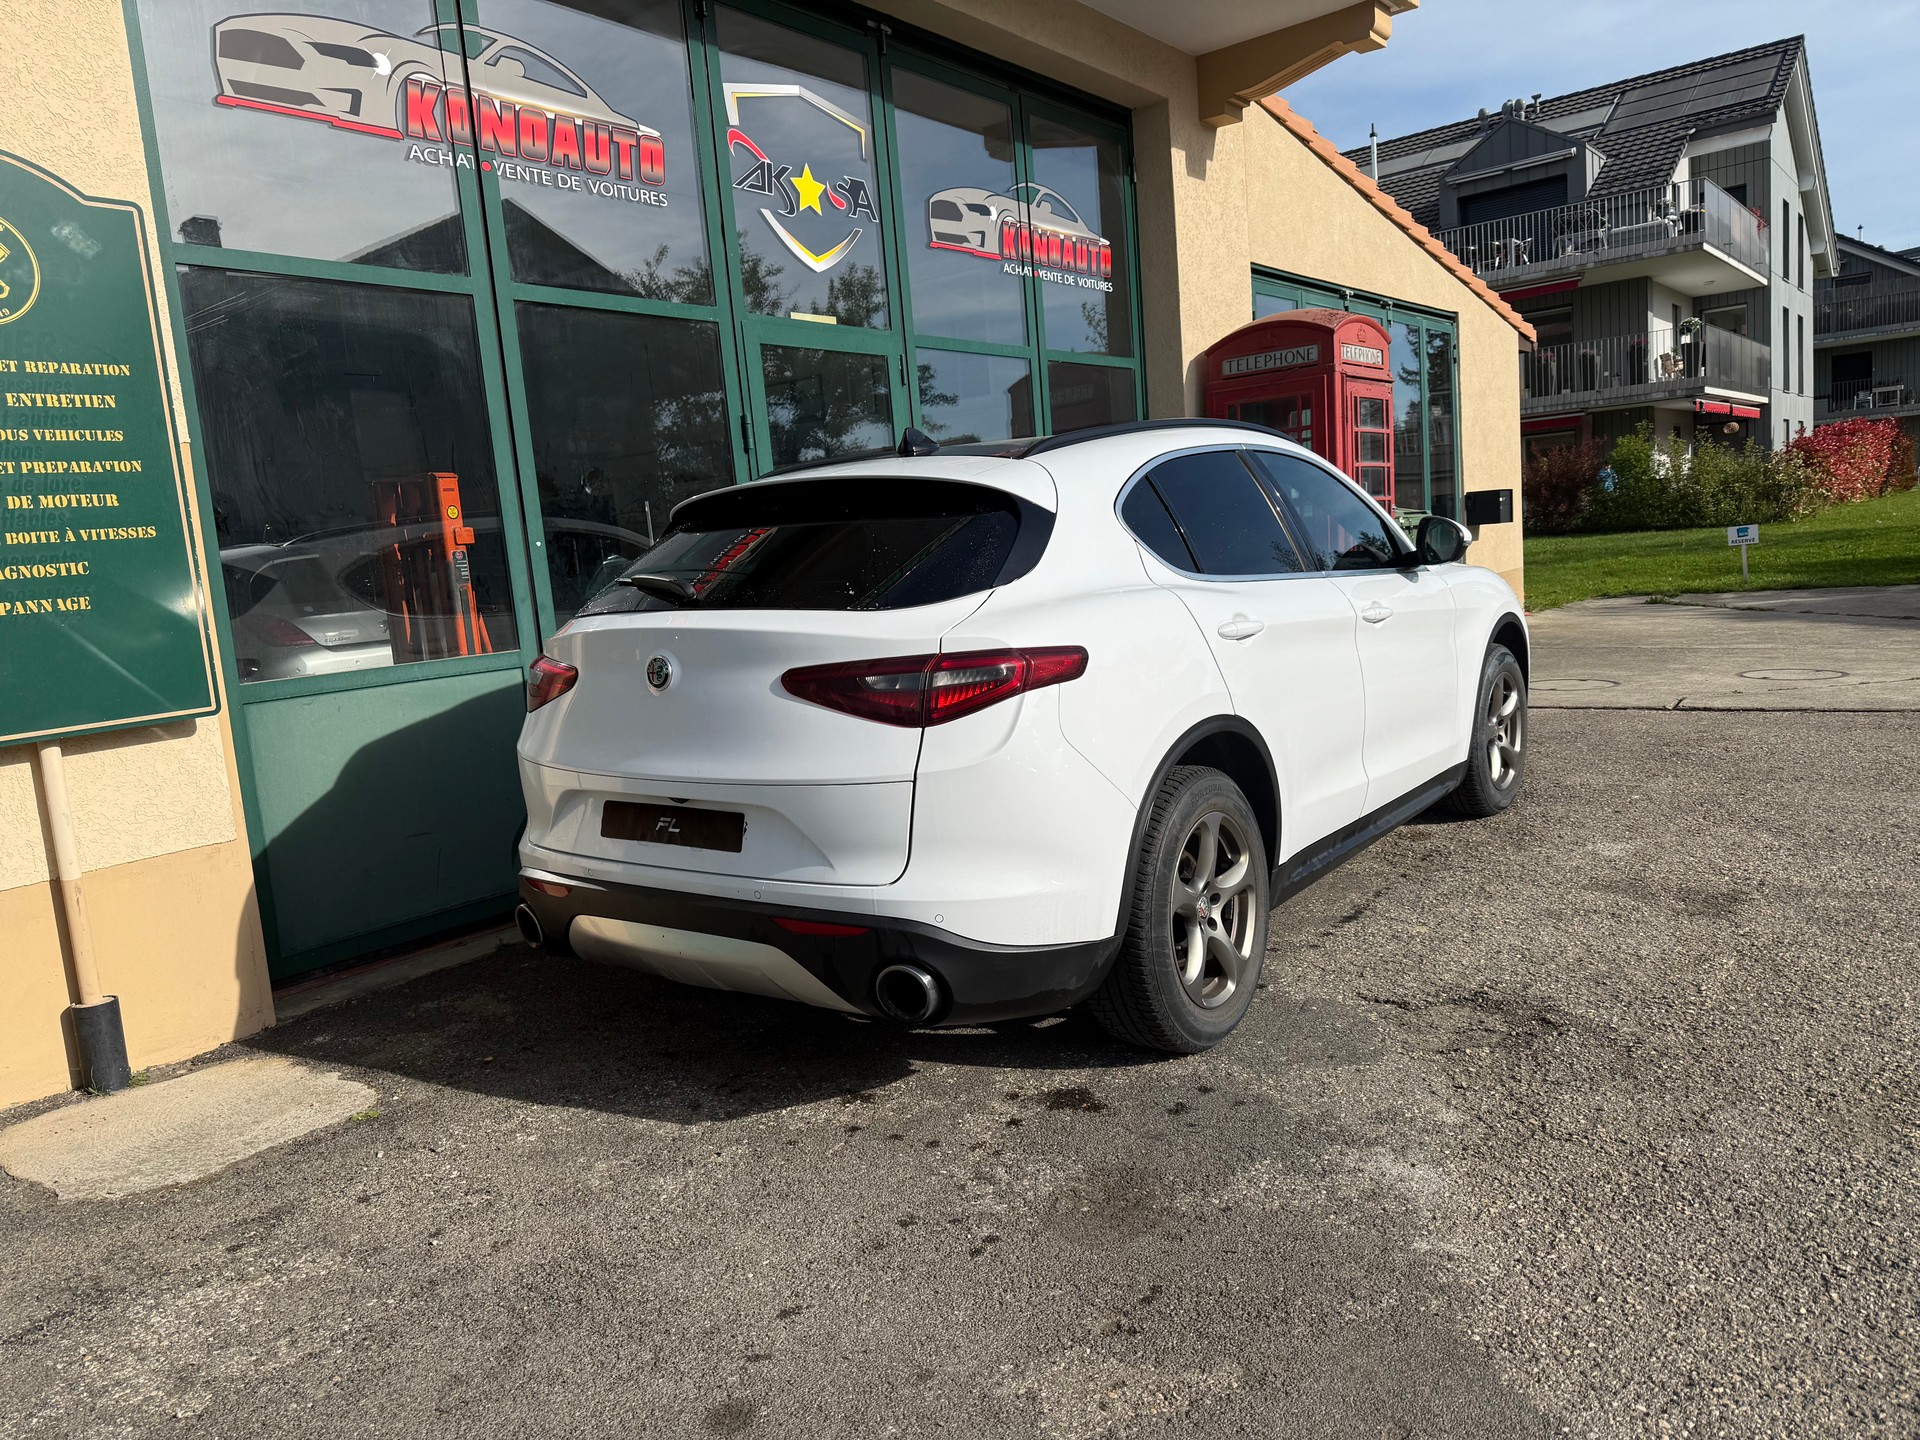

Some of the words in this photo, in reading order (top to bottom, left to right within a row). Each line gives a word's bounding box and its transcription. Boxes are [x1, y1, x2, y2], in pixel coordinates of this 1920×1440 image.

[406, 79, 666, 186] KONOAUTO
[492, 159, 553, 187] VENTE
[558, 173, 582, 192] DE
[588, 178, 669, 207] VOITURES
[1002, 220, 1112, 279] KONOAUTO
[1064, 274, 1076, 286] DE
[1077, 277, 1114, 293] VOITURES
[1225, 347, 1315, 374] TELEPHONE
[1341, 345, 1381, 364] TELEPHONE
[24, 360, 131, 376] REPARATION
[5, 392, 117, 408] ENTRETIEN
[32, 428, 124, 442] VEHICULES
[20, 460, 142, 474] PREPARATION
[6, 494, 34, 510] DE
[38, 493, 120, 509] MOTEUR
[5, 530, 60, 546] BOITE
[65, 527, 76, 544] À
[80, 526, 157, 542] VITESSES
[656, 816, 681, 833] FL
